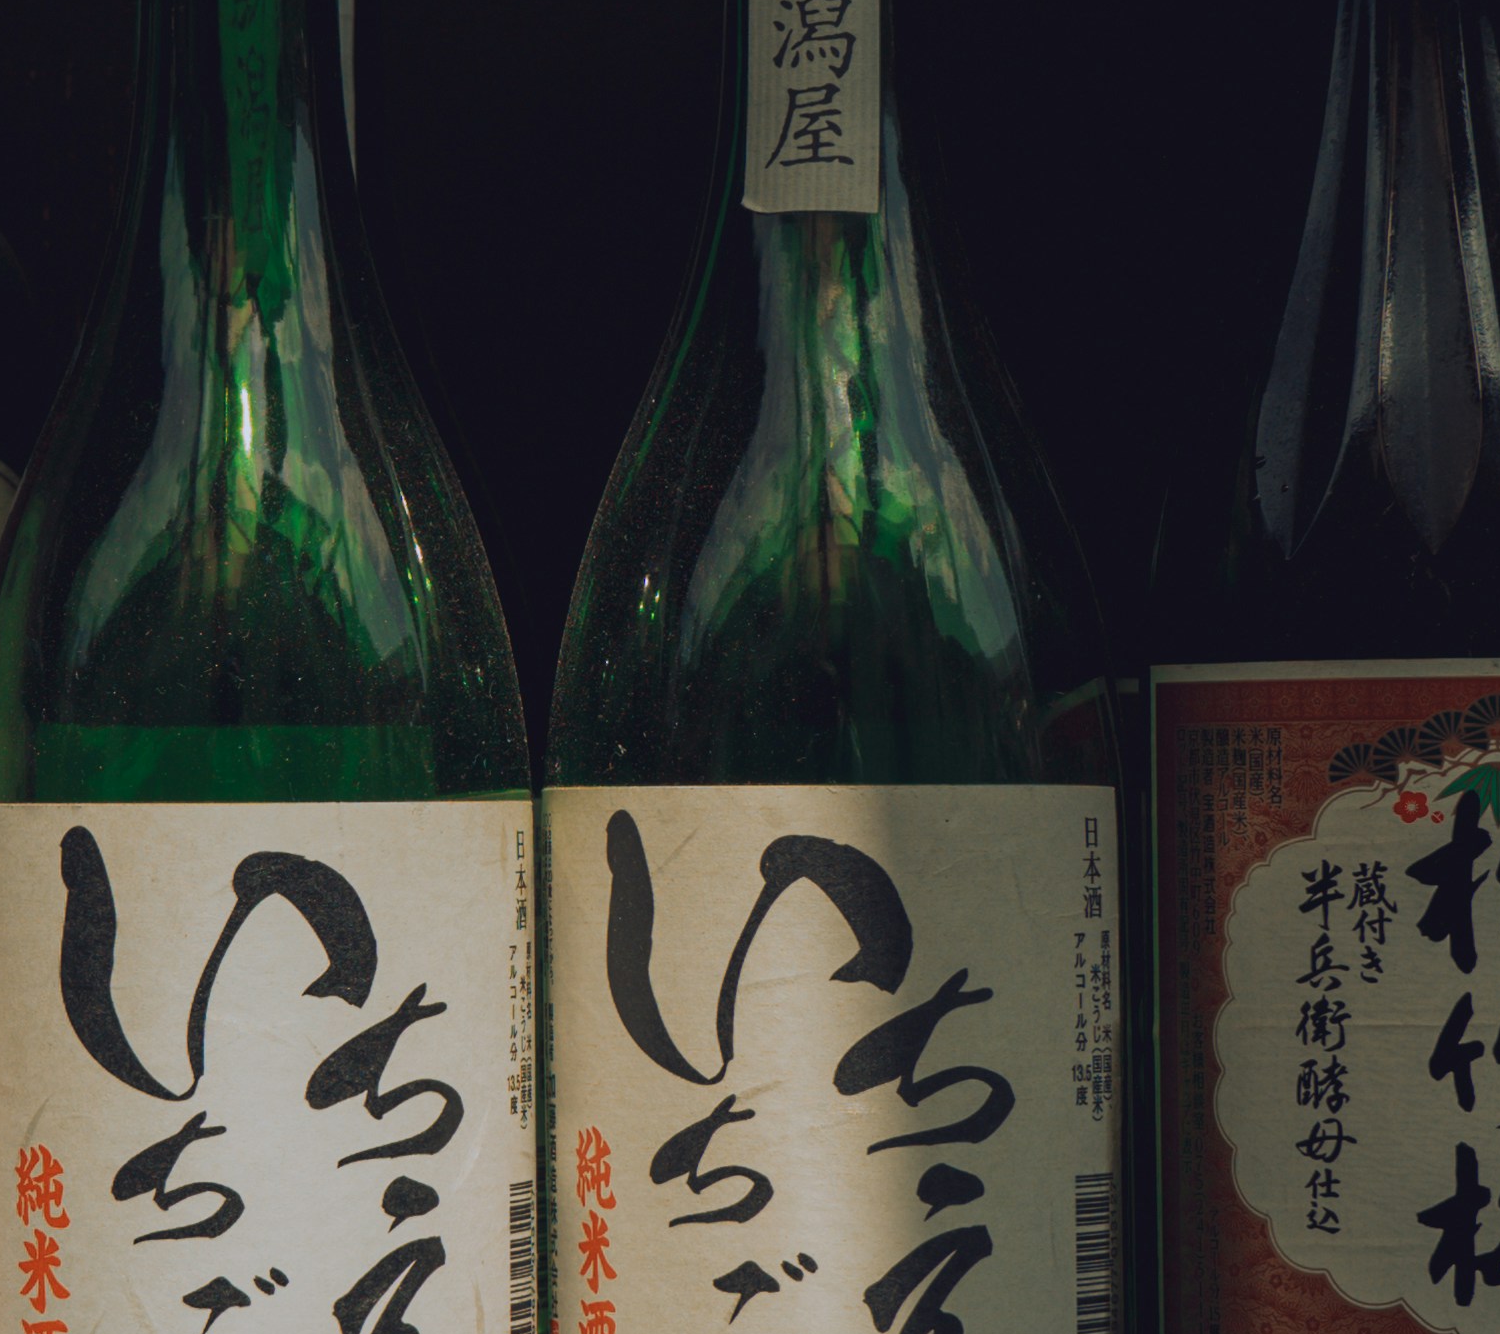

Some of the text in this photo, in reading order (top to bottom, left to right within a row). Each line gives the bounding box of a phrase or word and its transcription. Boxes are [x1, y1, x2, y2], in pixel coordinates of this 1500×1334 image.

[515, 830, 527, 931] 日本酒
[1081, 816, 1103, 919] 日本酒
[1347, 860, 1398, 985] 蔵付き
[509, 944, 518, 1062] アルコール分
[1073, 932, 1089, 1052] アルコール分
[1295, 858, 1358, 1234] 半兵衛酵母仕込
